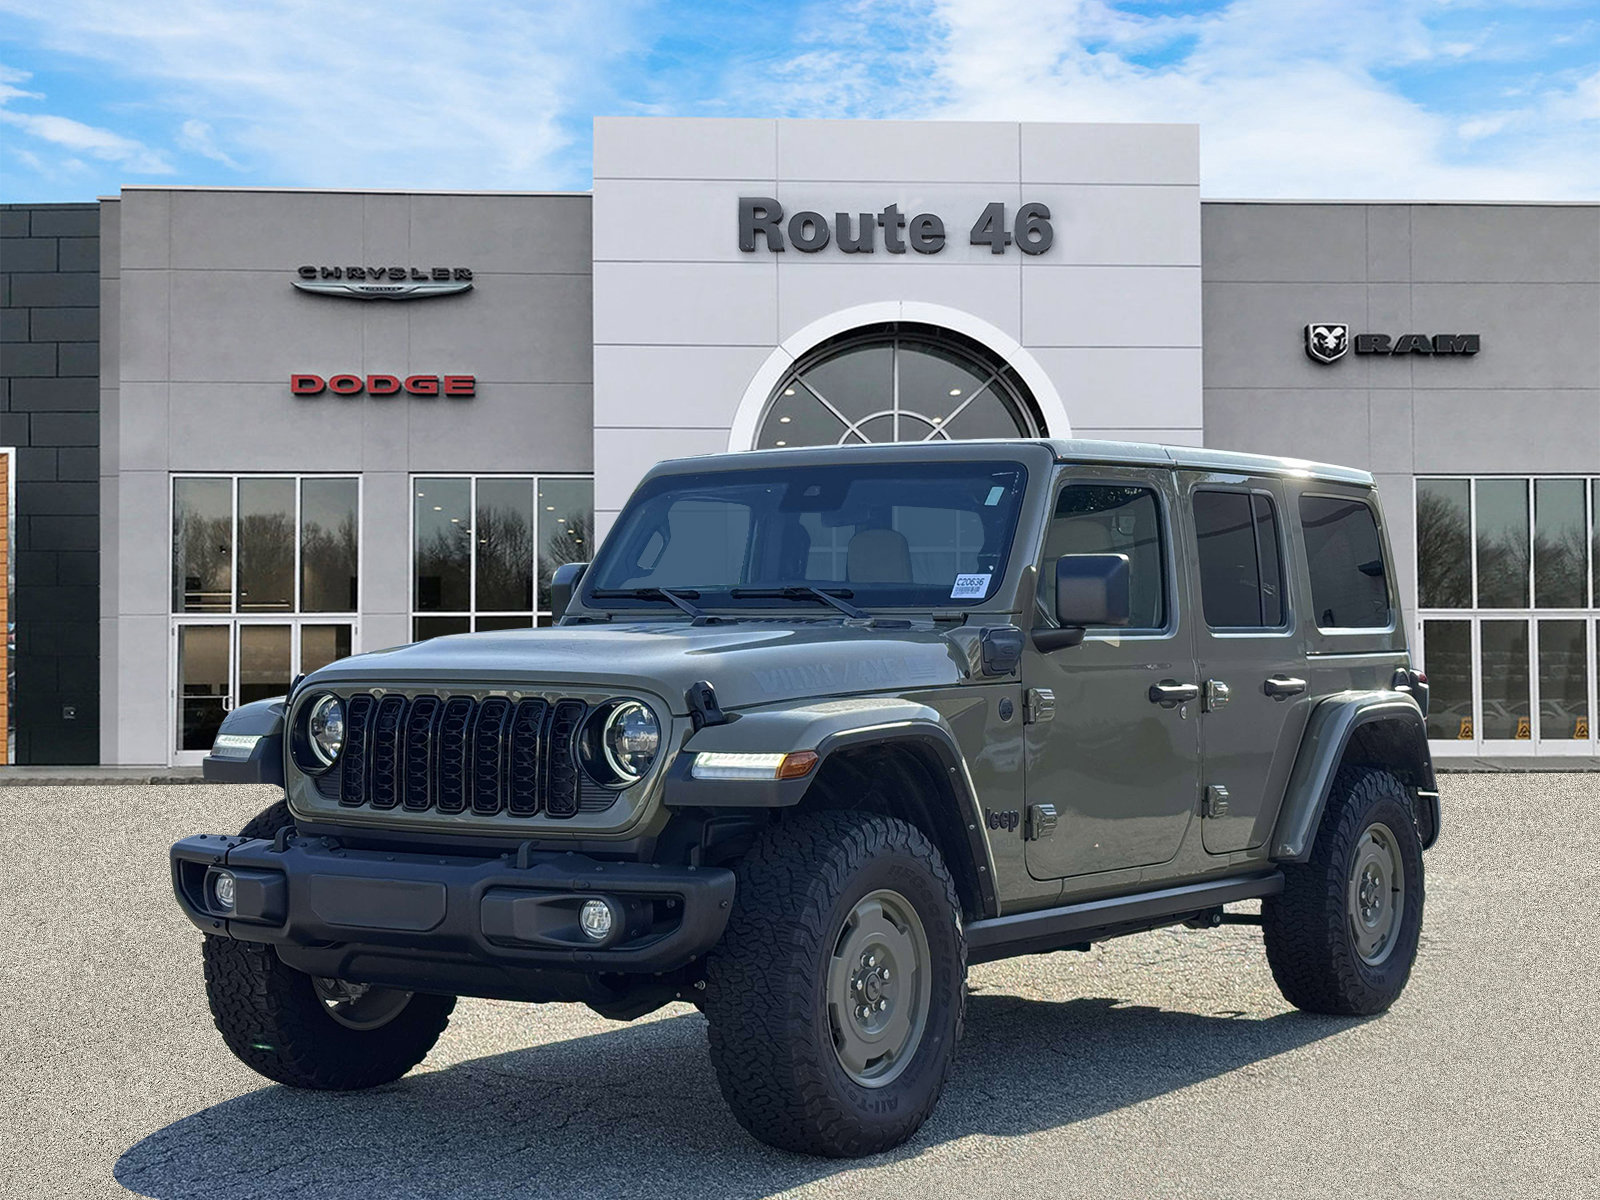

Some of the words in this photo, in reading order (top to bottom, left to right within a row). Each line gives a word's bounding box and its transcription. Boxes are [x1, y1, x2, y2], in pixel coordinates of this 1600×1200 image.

[738, 197, 946, 253] Route
[970, 202, 1054, 255] 46
[298, 266, 473, 281] CHRYSLER
[1354, 334, 1480, 355] RAM
[291, 374, 476, 397] DODGE
[985, 807, 1020, 832] Jeep
